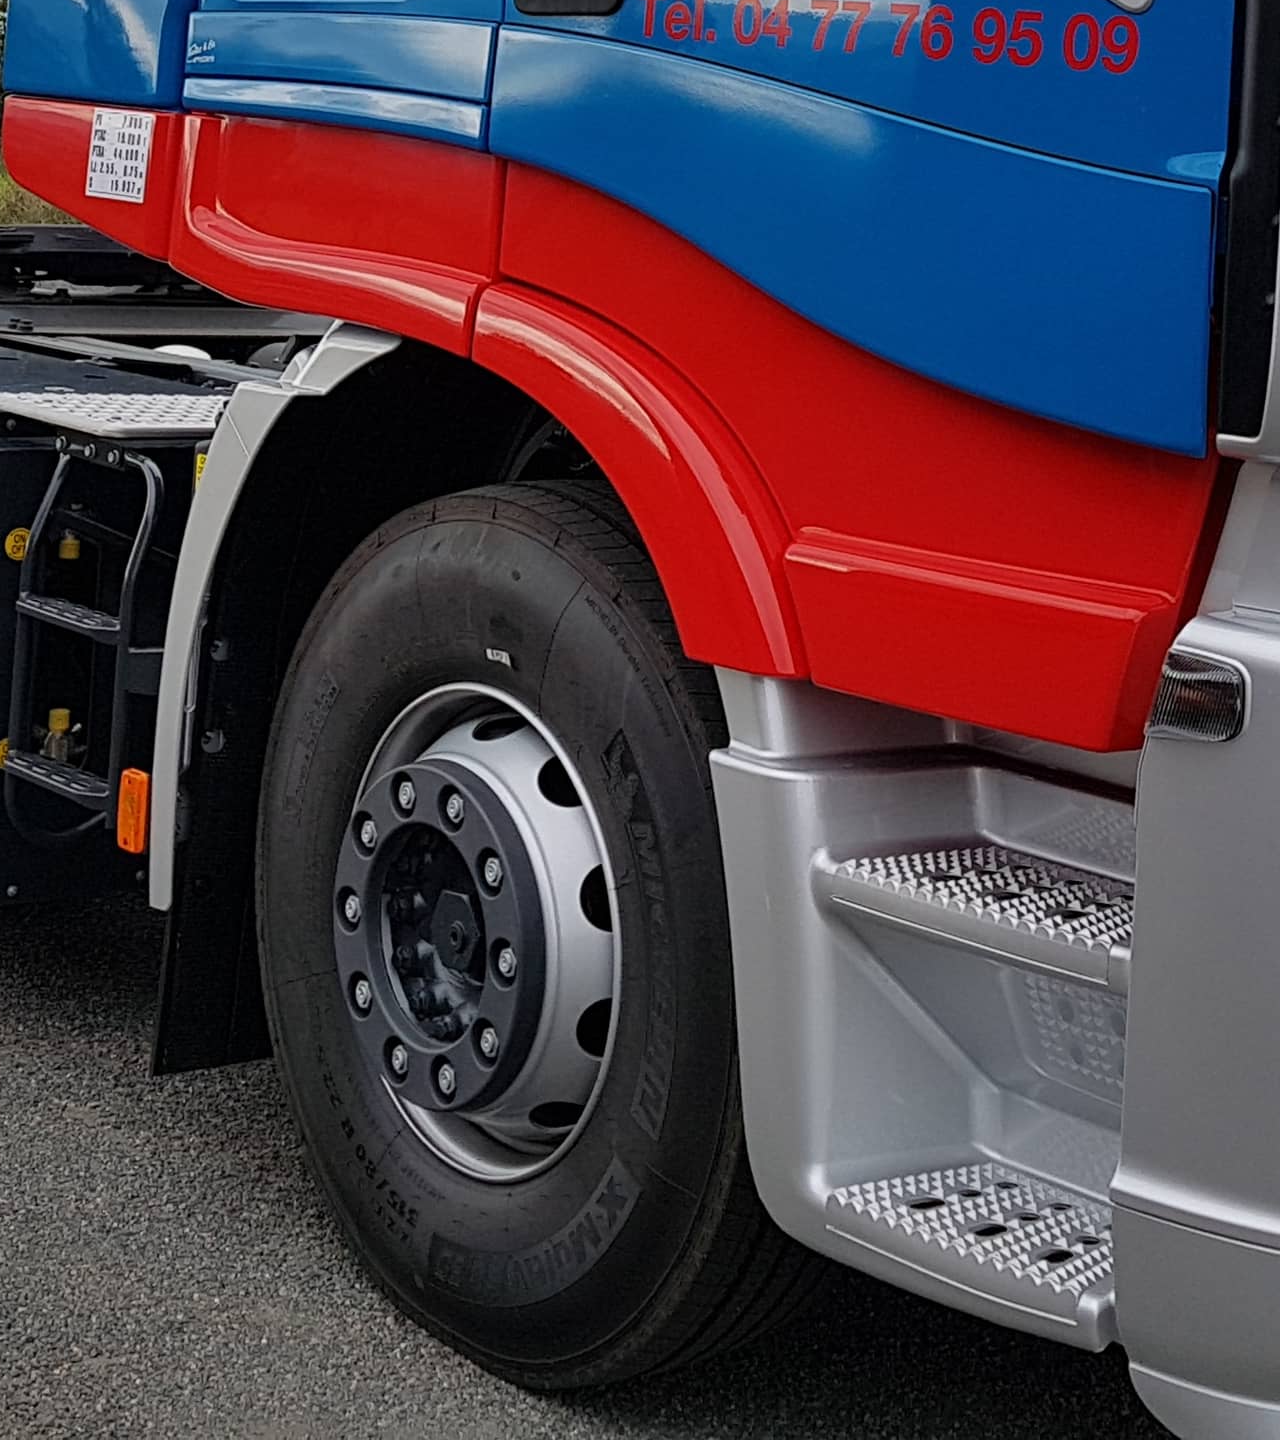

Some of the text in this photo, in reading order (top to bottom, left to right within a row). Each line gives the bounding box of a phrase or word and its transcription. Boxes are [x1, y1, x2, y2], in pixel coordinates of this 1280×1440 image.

[890, 2, 955, 61] 76
[970, 7, 1044, 68] 95
[1061, 11, 1142, 75] 09
